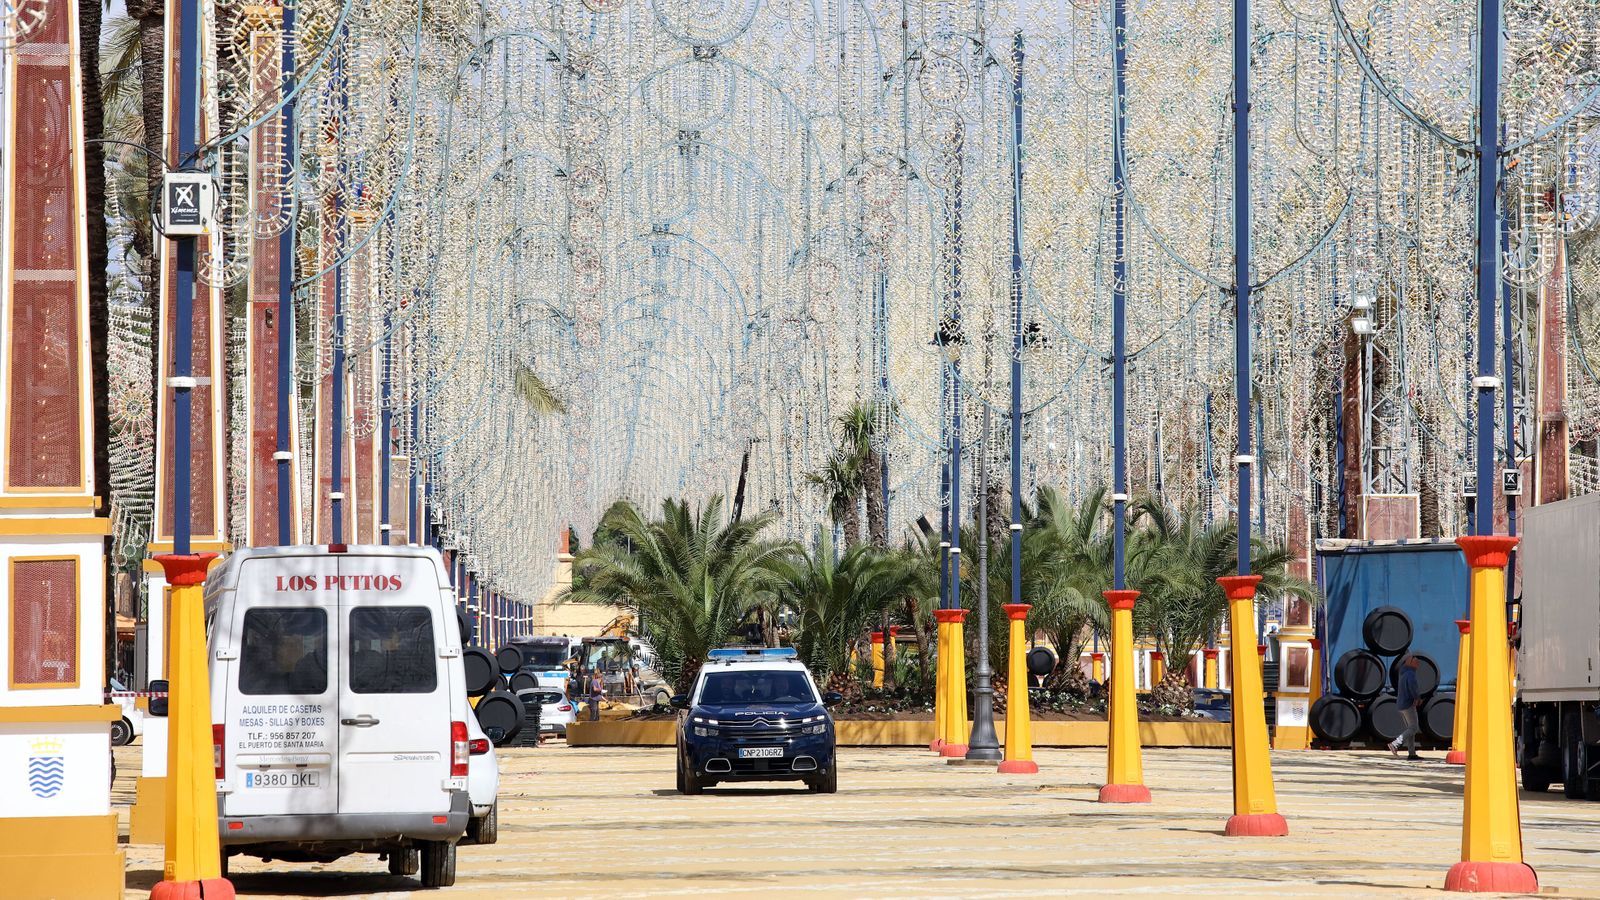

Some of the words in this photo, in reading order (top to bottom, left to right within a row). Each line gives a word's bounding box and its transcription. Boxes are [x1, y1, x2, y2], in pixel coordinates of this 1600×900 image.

[275, 574, 318, 592] LOS
[324, 574, 402, 592] PUITOS
[242, 705, 277, 714] ALQUILER
[278, 705, 288, 714] DE
[290, 705, 322, 714] CASETAS
[239, 718, 264, 727] MESAS
[269, 718, 294, 727] SILLAS
[294, 717, 300, 727] Y
[301, 717, 325, 727] BOXES
[270, 732, 284, 740] 956
[285, 731, 300, 740] 857
[301, 731, 316, 740] 207
[238, 741, 246, 749] EL
[247, 741, 273, 749] PUERTO
[254, 774, 287, 786] 9380
[291, 773, 316, 786] DKL
